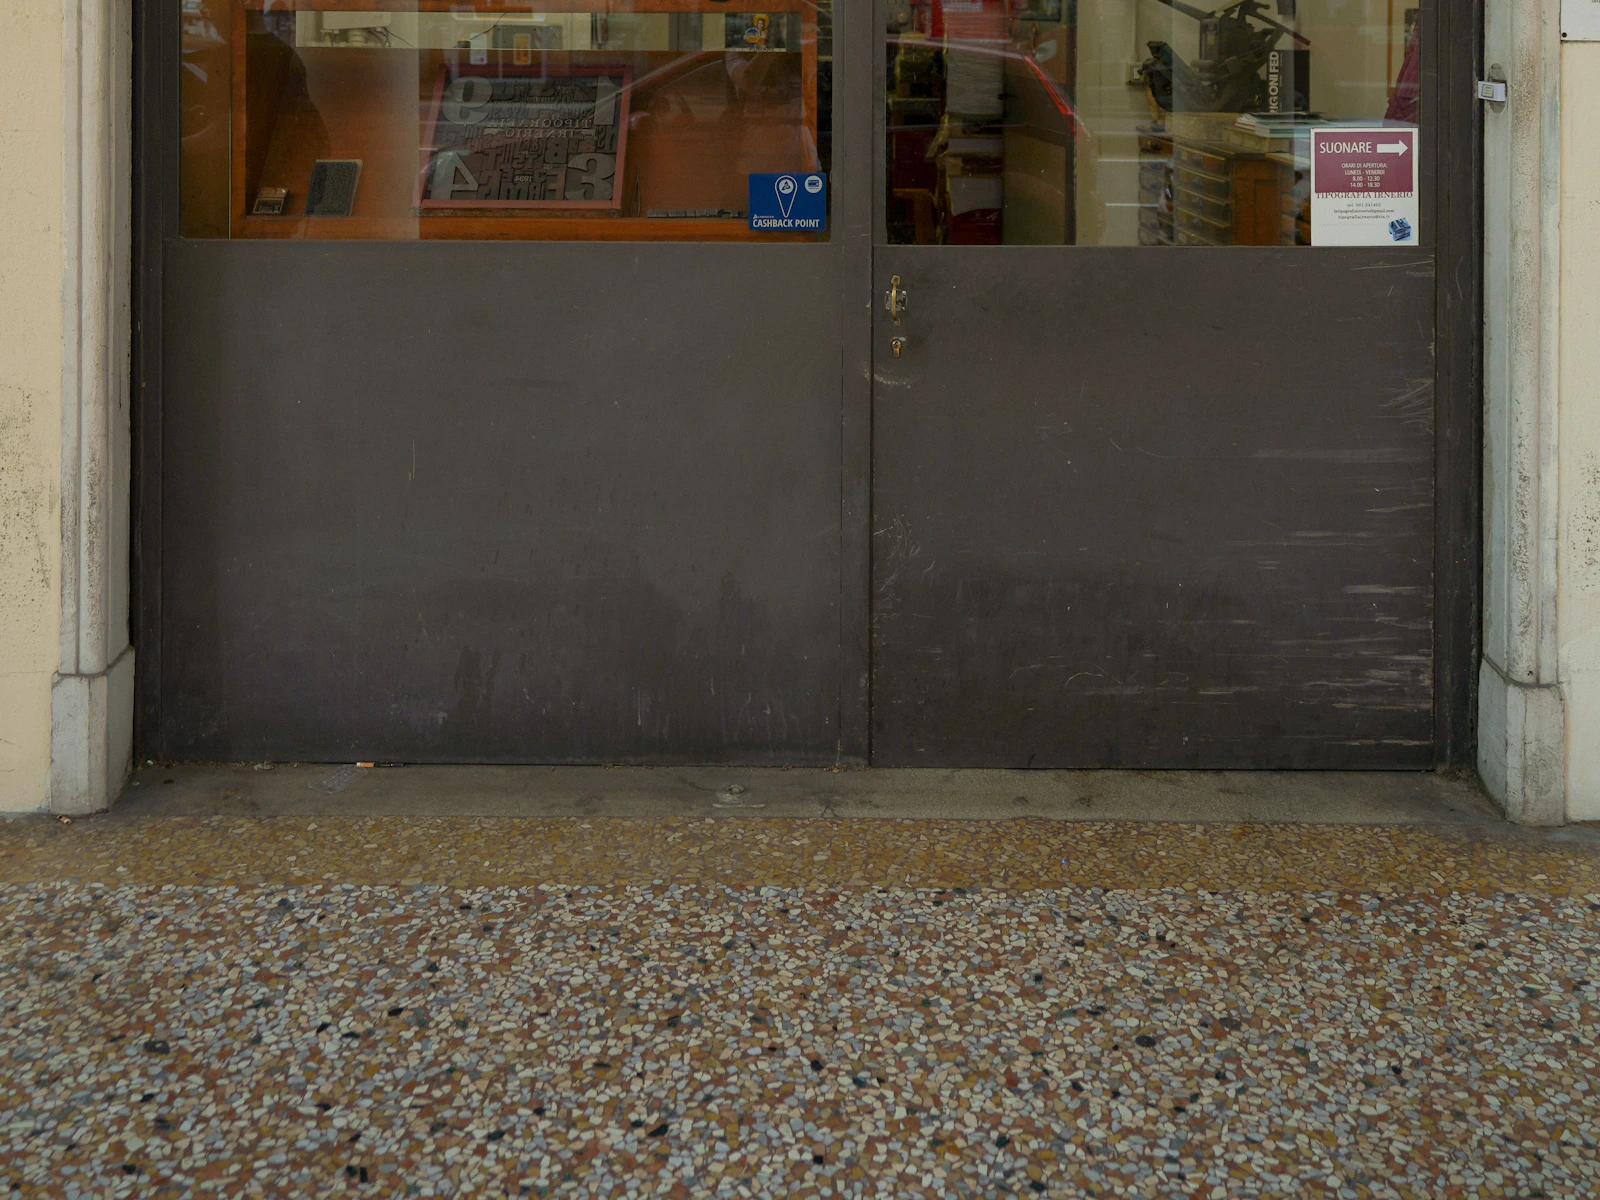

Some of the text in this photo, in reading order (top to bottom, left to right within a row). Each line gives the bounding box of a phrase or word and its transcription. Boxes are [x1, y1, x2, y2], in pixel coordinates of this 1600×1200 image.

[1320, 142, 1372, 153] SUONARE
[752, 218, 820, 228] CASHBACK POINT
